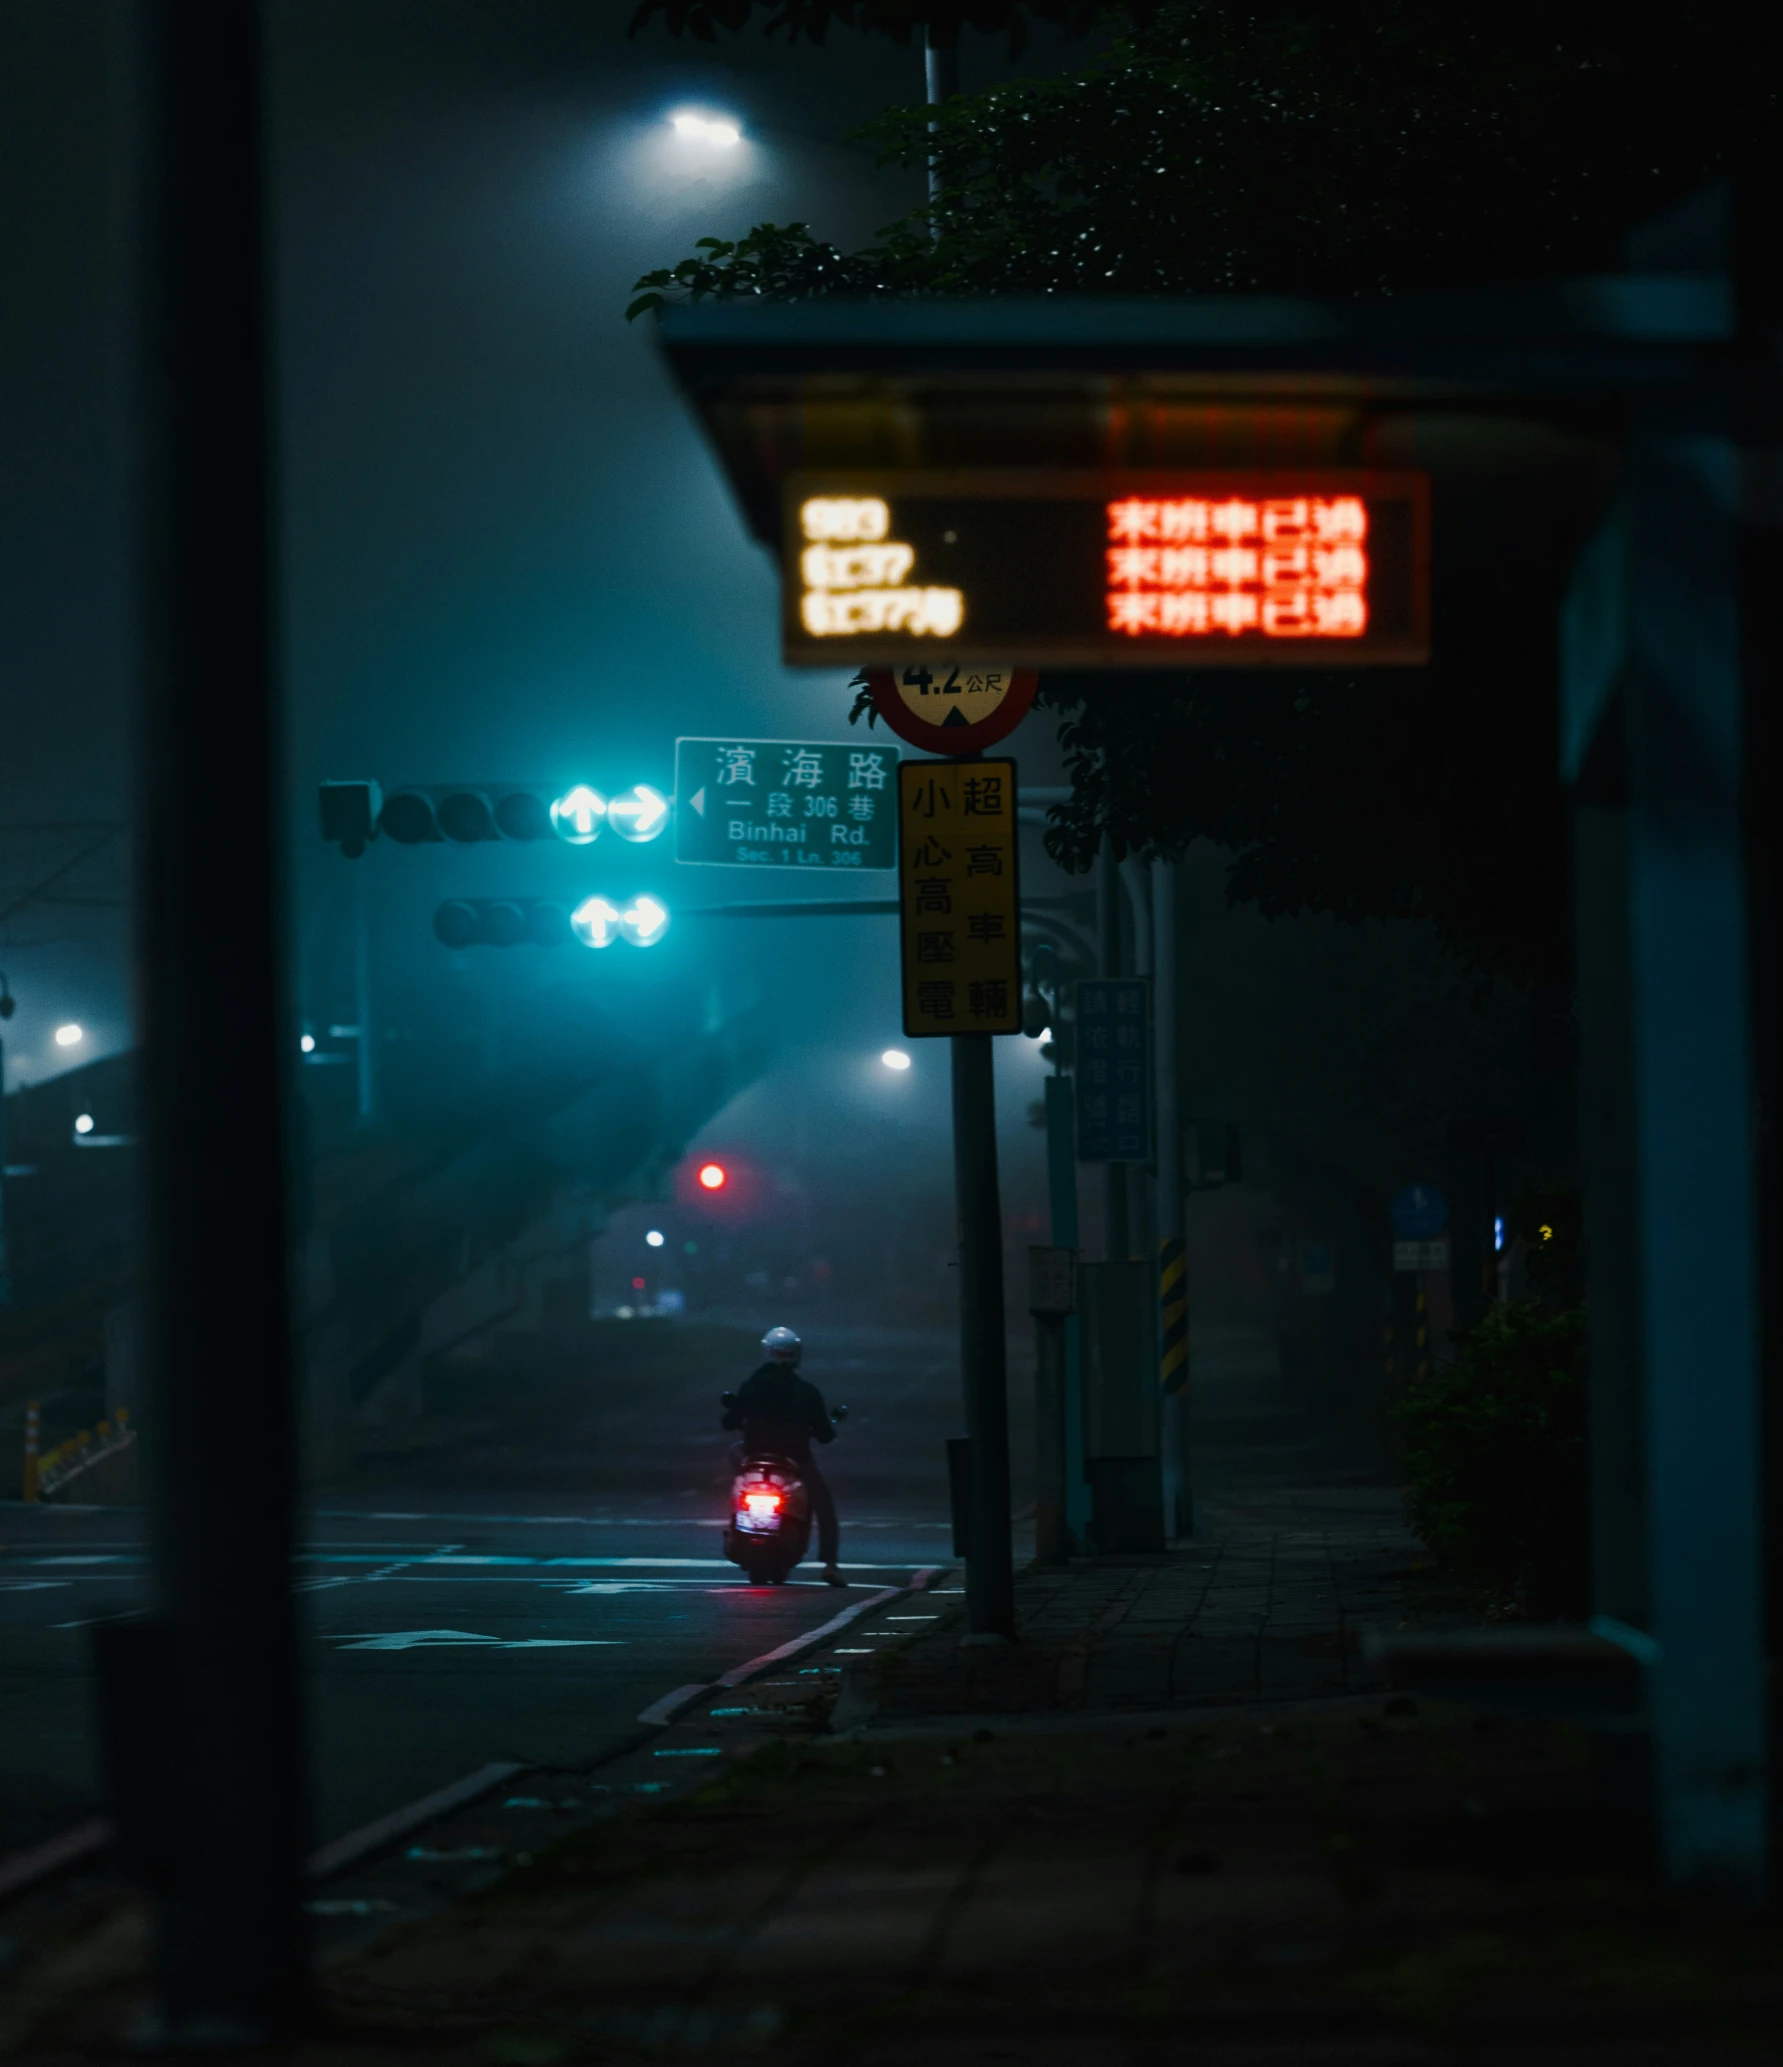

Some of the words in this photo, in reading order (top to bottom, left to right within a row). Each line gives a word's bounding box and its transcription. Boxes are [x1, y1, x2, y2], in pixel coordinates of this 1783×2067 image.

[716, 745, 888, 790] 濱海路
[725, 791, 876, 822] 一段306巷
[728, 820, 807, 843] Binhai
[830, 824, 870, 846] Rd.
[782, 848, 791, 862] 1
[831, 850, 862, 866] 306
[912, 778, 956, 1019] 小心高壓電
[963, 777, 1007, 1019] 超高車輛
